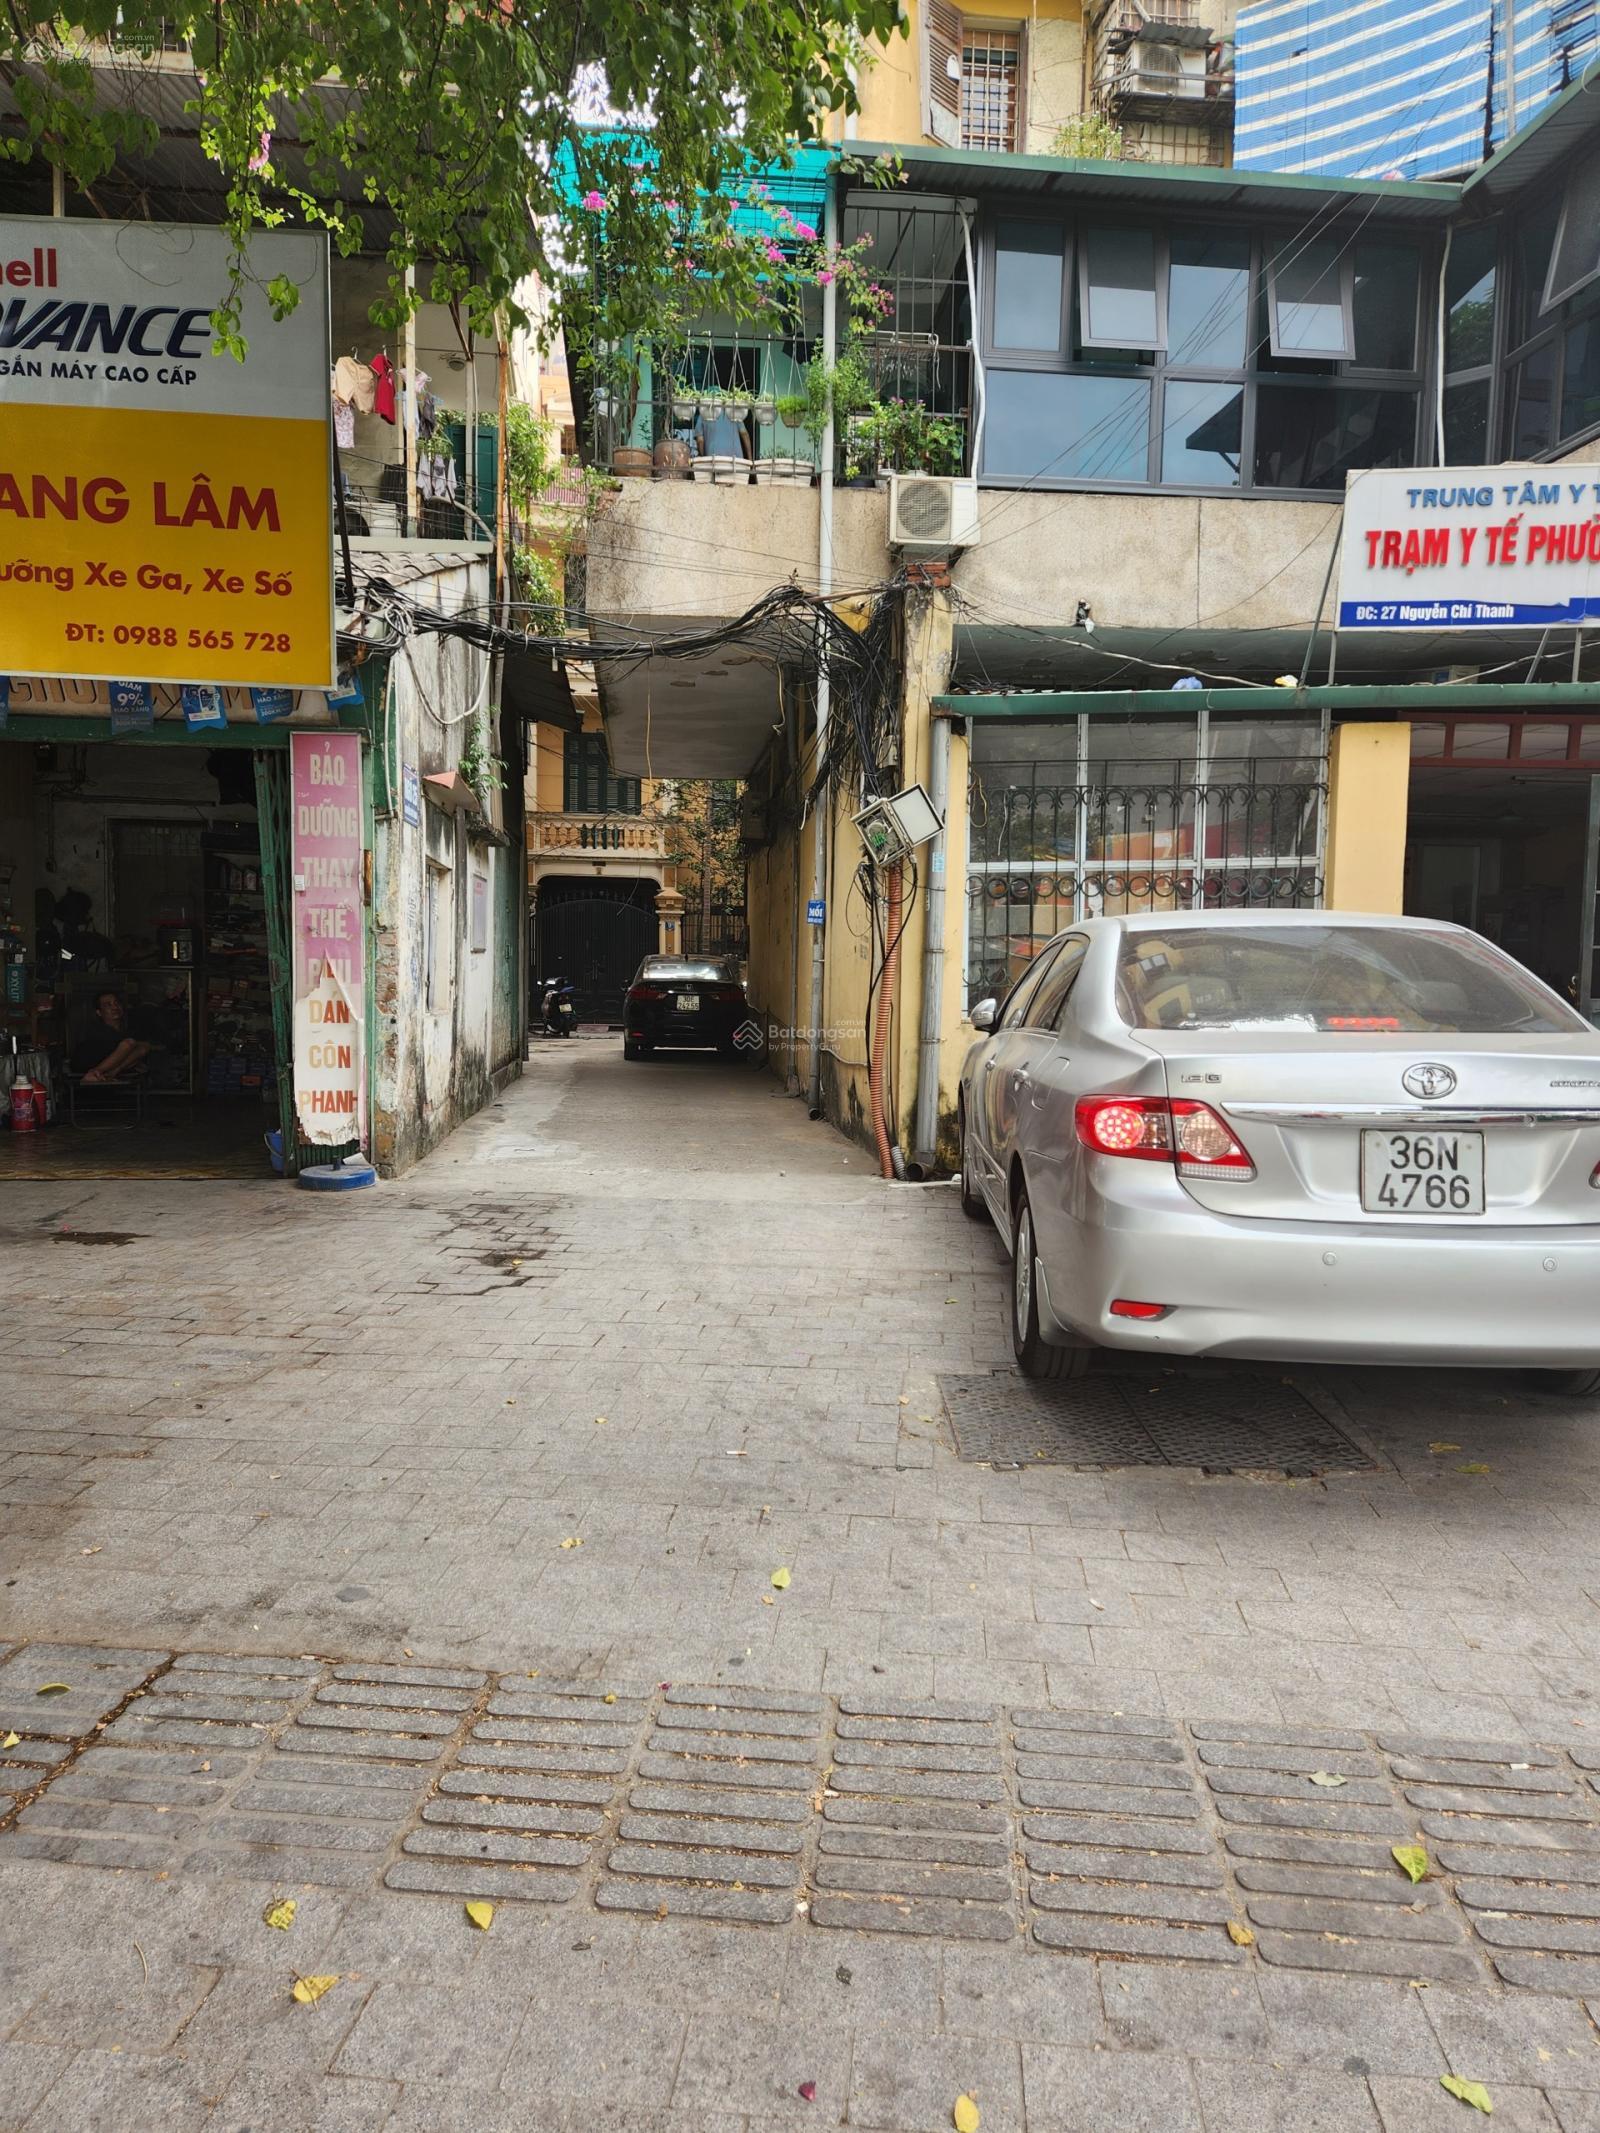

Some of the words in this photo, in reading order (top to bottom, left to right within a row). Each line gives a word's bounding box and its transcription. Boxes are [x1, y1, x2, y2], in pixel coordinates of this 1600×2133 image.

[0, 247, 57, 288] ell
[0, 297, 215, 359] VANCE
[51, 359, 97, 380] MÁY
[105, 366, 149, 383] CAO
[157, 365, 197, 385] CẤP
[154, 472, 281, 532] LÂM
[1407, 487, 1494, 507] TRUNG
[1503, 480, 1560, 505] TÂM
[1569, 484, 1586, 504] Y
[1365, 528, 1450, 575] TRẠM
[1461, 527, 1478, 567] Y
[1486, 513, 1525, 566] TẾ
[84, 561, 127, 587] Xe
[137, 564, 192, 595] Ga,
[202, 567, 244, 594] Xe
[254, 571, 292, 596] Số
[1356, 605, 1378, 620] ĐC:
[1381, 605, 1397, 620] 27
[1400, 603, 1447, 621] Nguyễn
[1451, 603, 1472, 618] Chí
[1475, 604, 1514, 618] Thanh
[65, 624, 105, 643] ĐT:
[114, 625, 178, 647] 0988
[188, 629, 234, 649] 565
[244, 632, 291, 652] 728
[117, 692, 144, 706] 9%
[310, 741, 345, 785] BẢO
[298, 798, 358, 838] DƯỠNG
[300, 857, 356, 888] THAY
[308, 899, 352, 939] THẾ
[308, 1040, 351, 1068] CÔN
[1390, 1136, 1459, 1171] 36N
[1378, 1174, 1471, 1208] 4766
